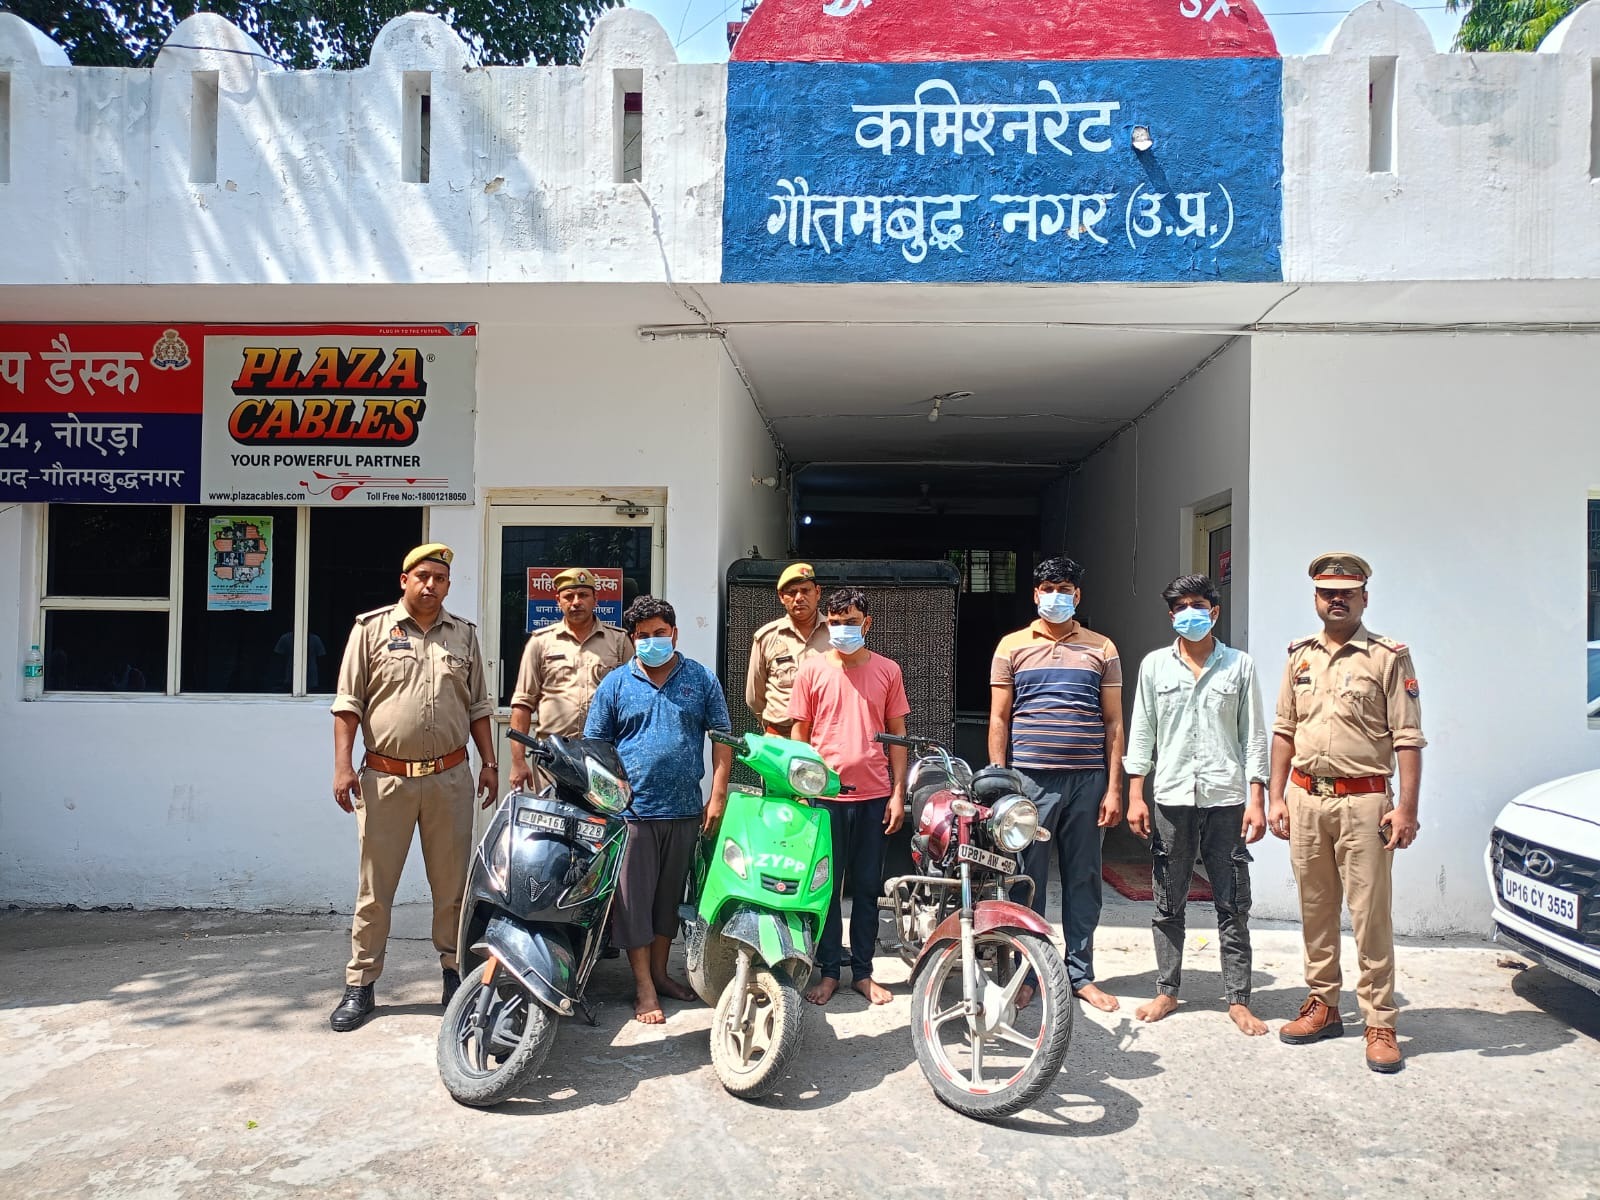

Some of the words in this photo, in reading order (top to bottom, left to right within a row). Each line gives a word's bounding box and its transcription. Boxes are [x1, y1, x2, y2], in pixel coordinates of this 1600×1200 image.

[852, 79, 1120, 156] कमिश्नरेट
[768, 177, 979, 264] गौतमबुद्ध
[989, 192, 1119, 245] नगर
[1125, 183, 1235, 249] (उ.प्र.)
[40, 333, 144, 396] डैस्क
[231, 347, 427, 396] PLAZA
[50, 412, 143, 457] नोएड़ा
[228, 399, 426, 447] CABLES
[231, 455, 270, 467] YOUR
[274, 455, 352, 467] POWERFUL
[355, 455, 421, 467] PARTNER
[208, 492, 305, 502] www.plazacables.com
[366, 492, 381, 501] Toll
[382, 492, 400, 501] Free
[754, 853, 806, 873] ZYPP
[1506, 879, 1528, 903] UP16
[1531, 888, 1544, 908] CY
[1548, 894, 1574, 920] 3553
